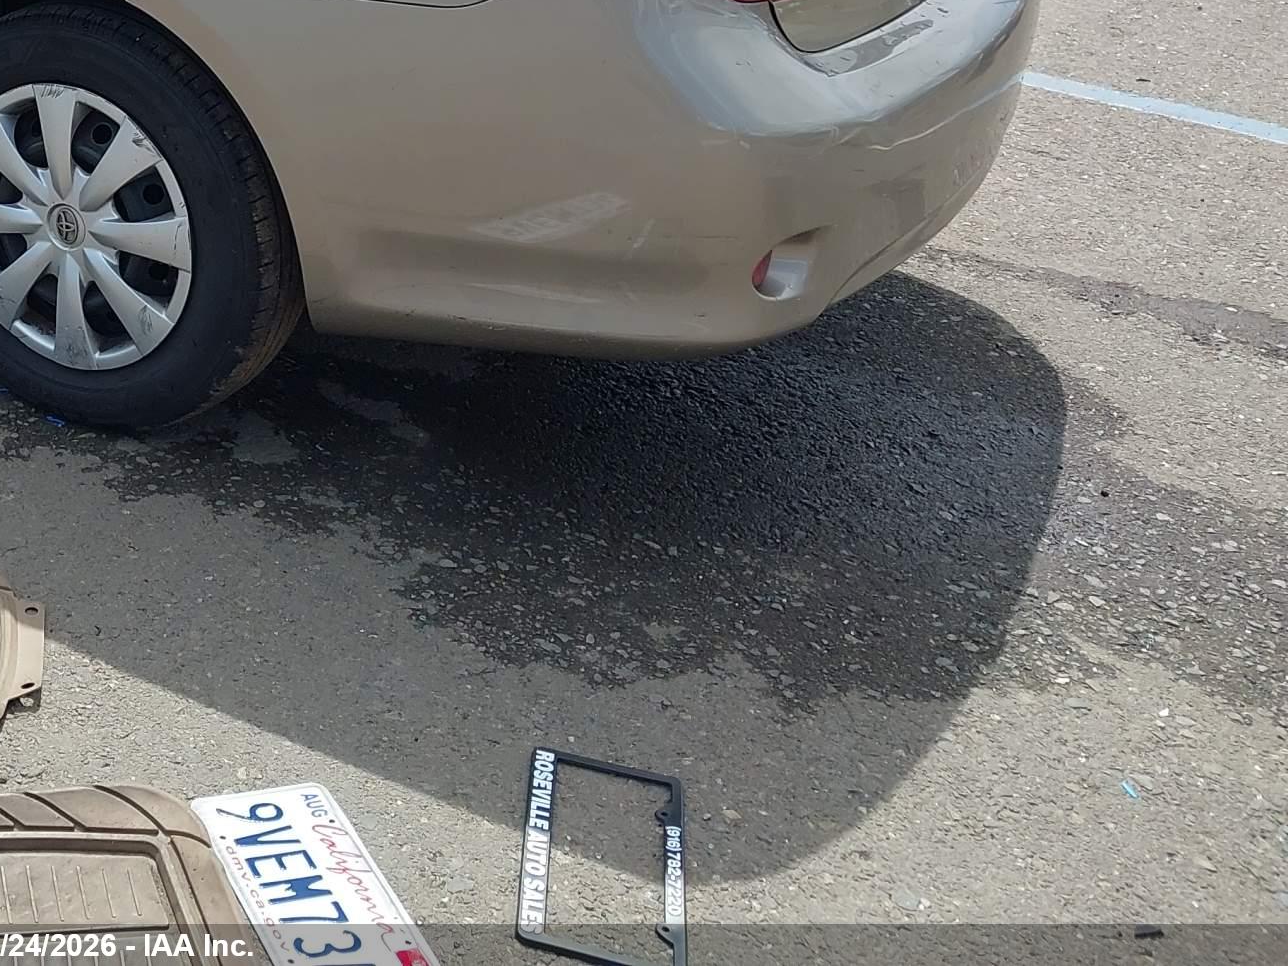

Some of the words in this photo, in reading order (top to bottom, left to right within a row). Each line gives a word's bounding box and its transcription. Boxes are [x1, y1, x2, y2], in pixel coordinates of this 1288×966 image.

[300, 793, 328, 818] AUG
[529, 749, 554, 830] ROSEVILLE
[216, 802, 376, 966] 9VEM73
[312, 824, 396, 951] California
[525, 830, 549, 876] AUTO
[665, 825, 682, 916] (916)782-7220
[225, 846, 289, 951] dmv.ca.gov
[520, 877, 545, 934] SALES
